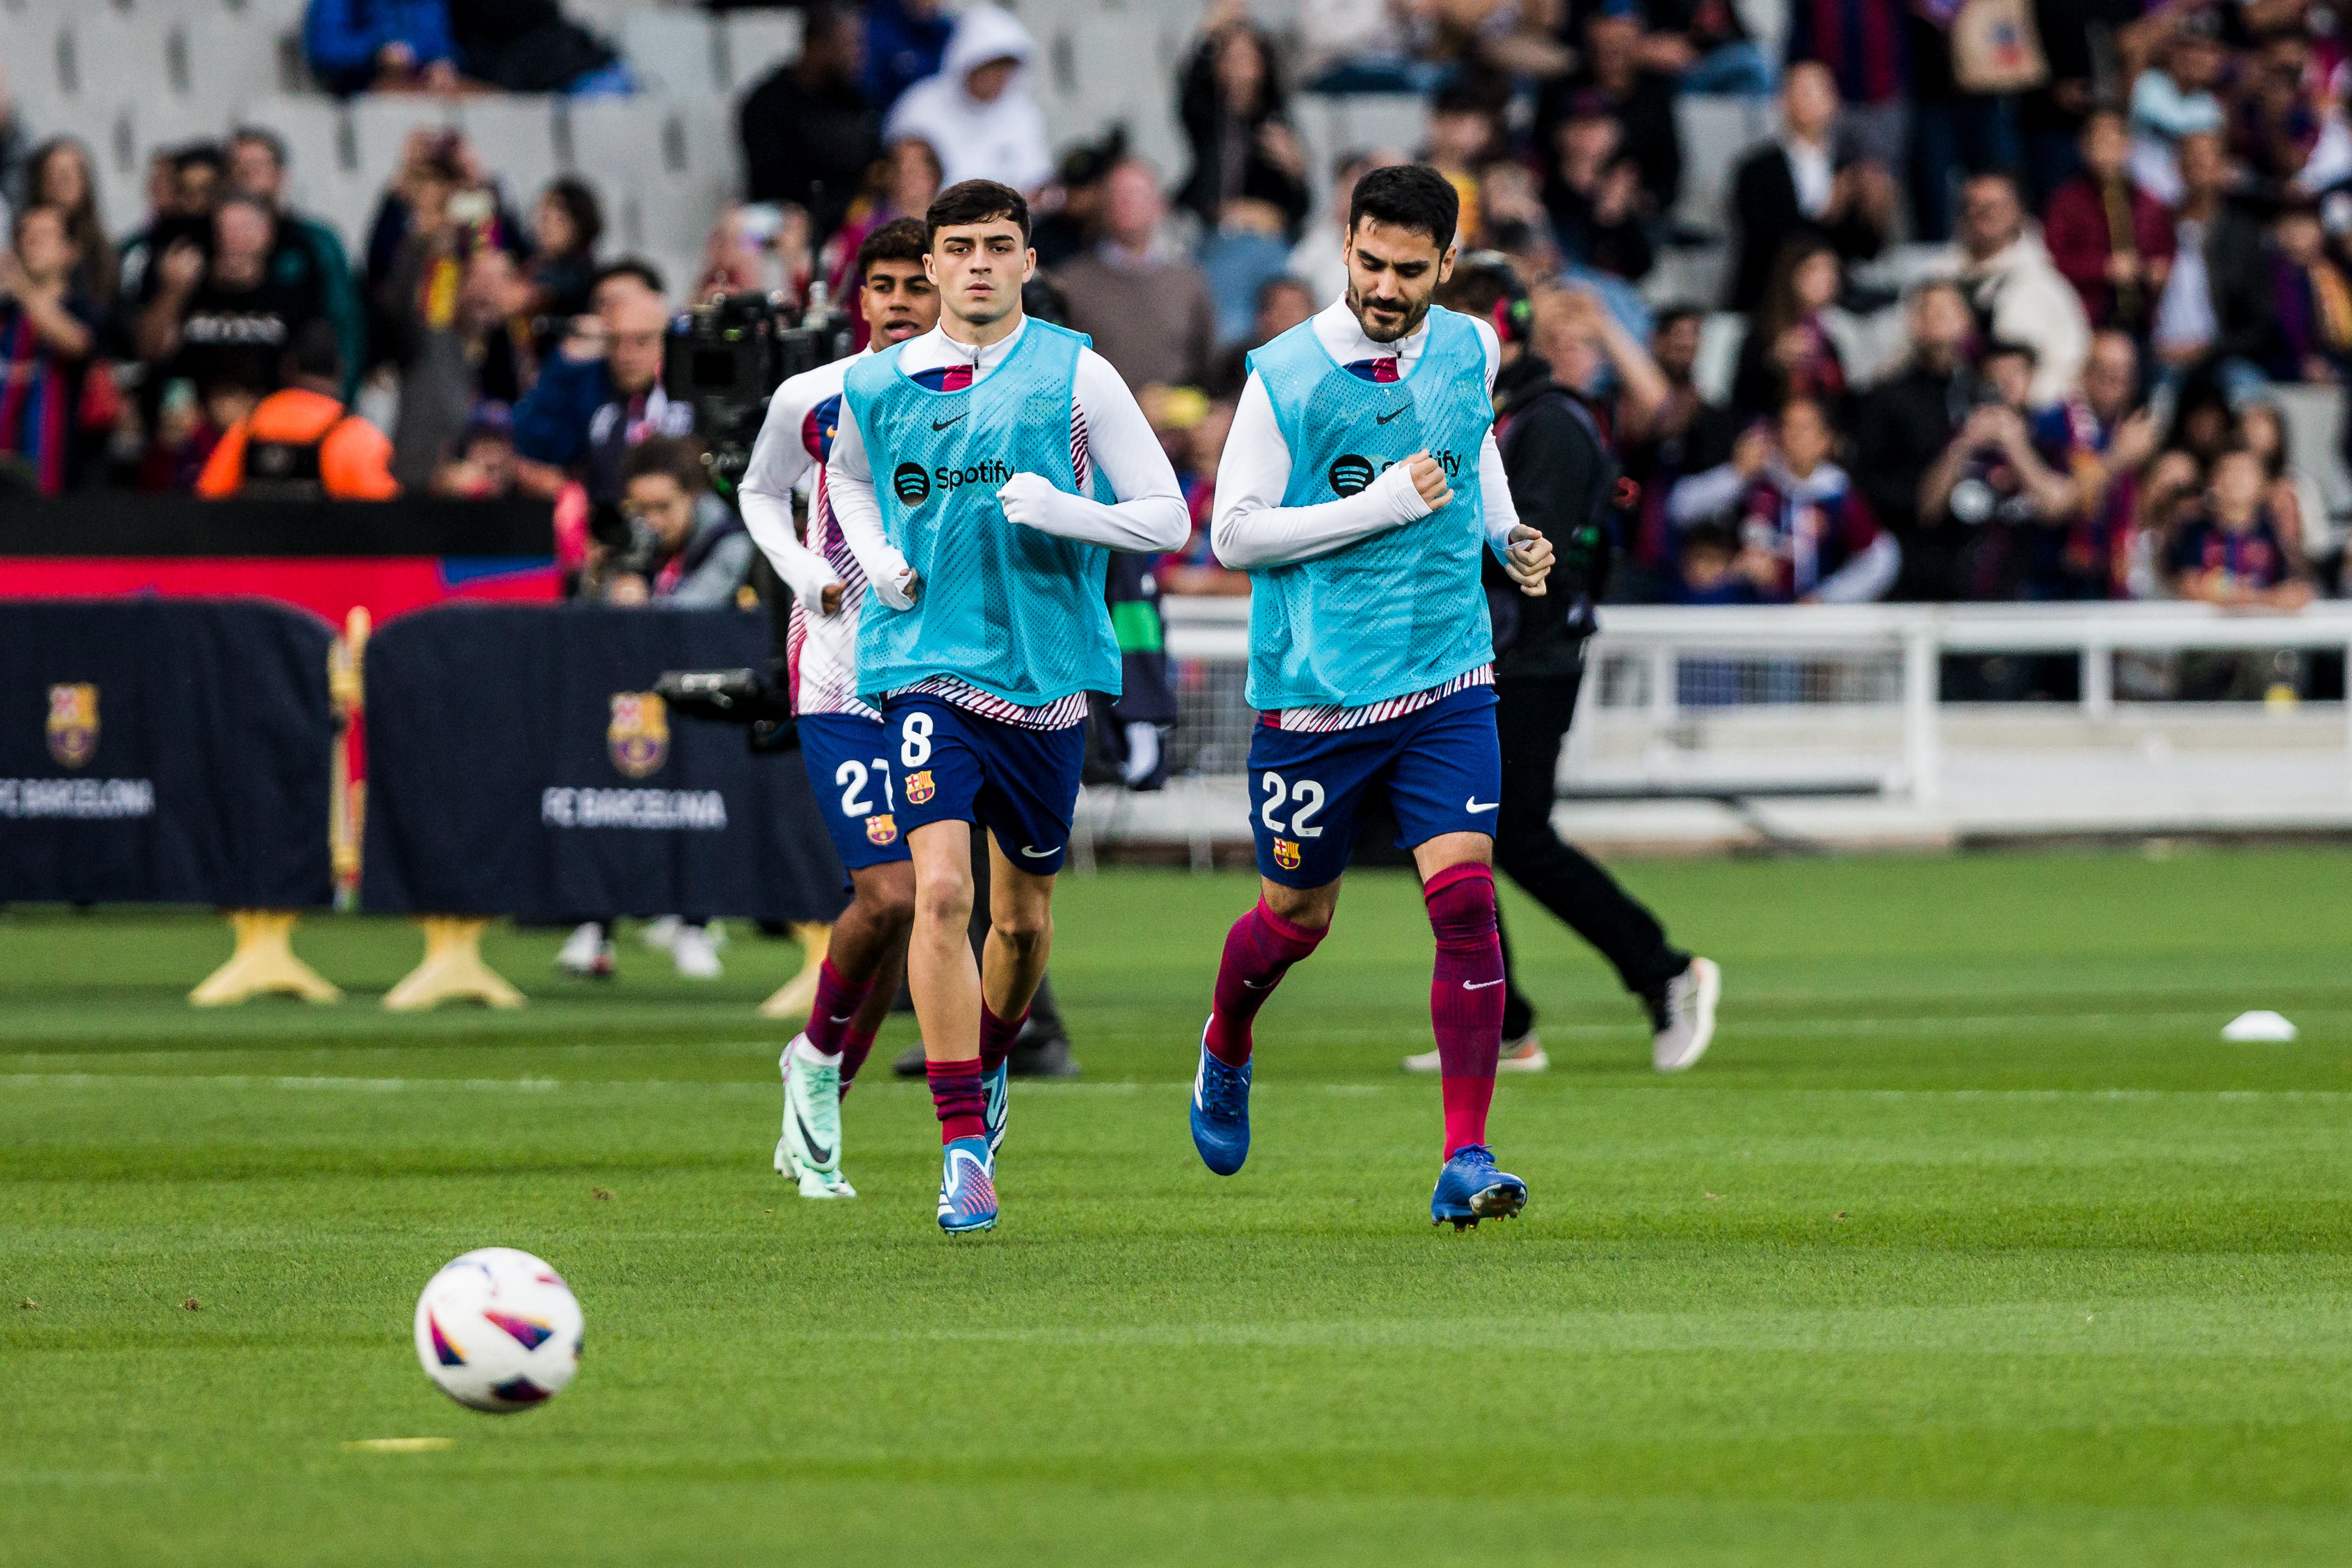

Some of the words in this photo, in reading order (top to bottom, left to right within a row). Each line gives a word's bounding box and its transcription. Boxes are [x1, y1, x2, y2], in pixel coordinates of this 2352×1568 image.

[935, 460, 1016, 492] Spotify
[901, 712, 933, 768] 8
[1262, 771, 1325, 837] 22
